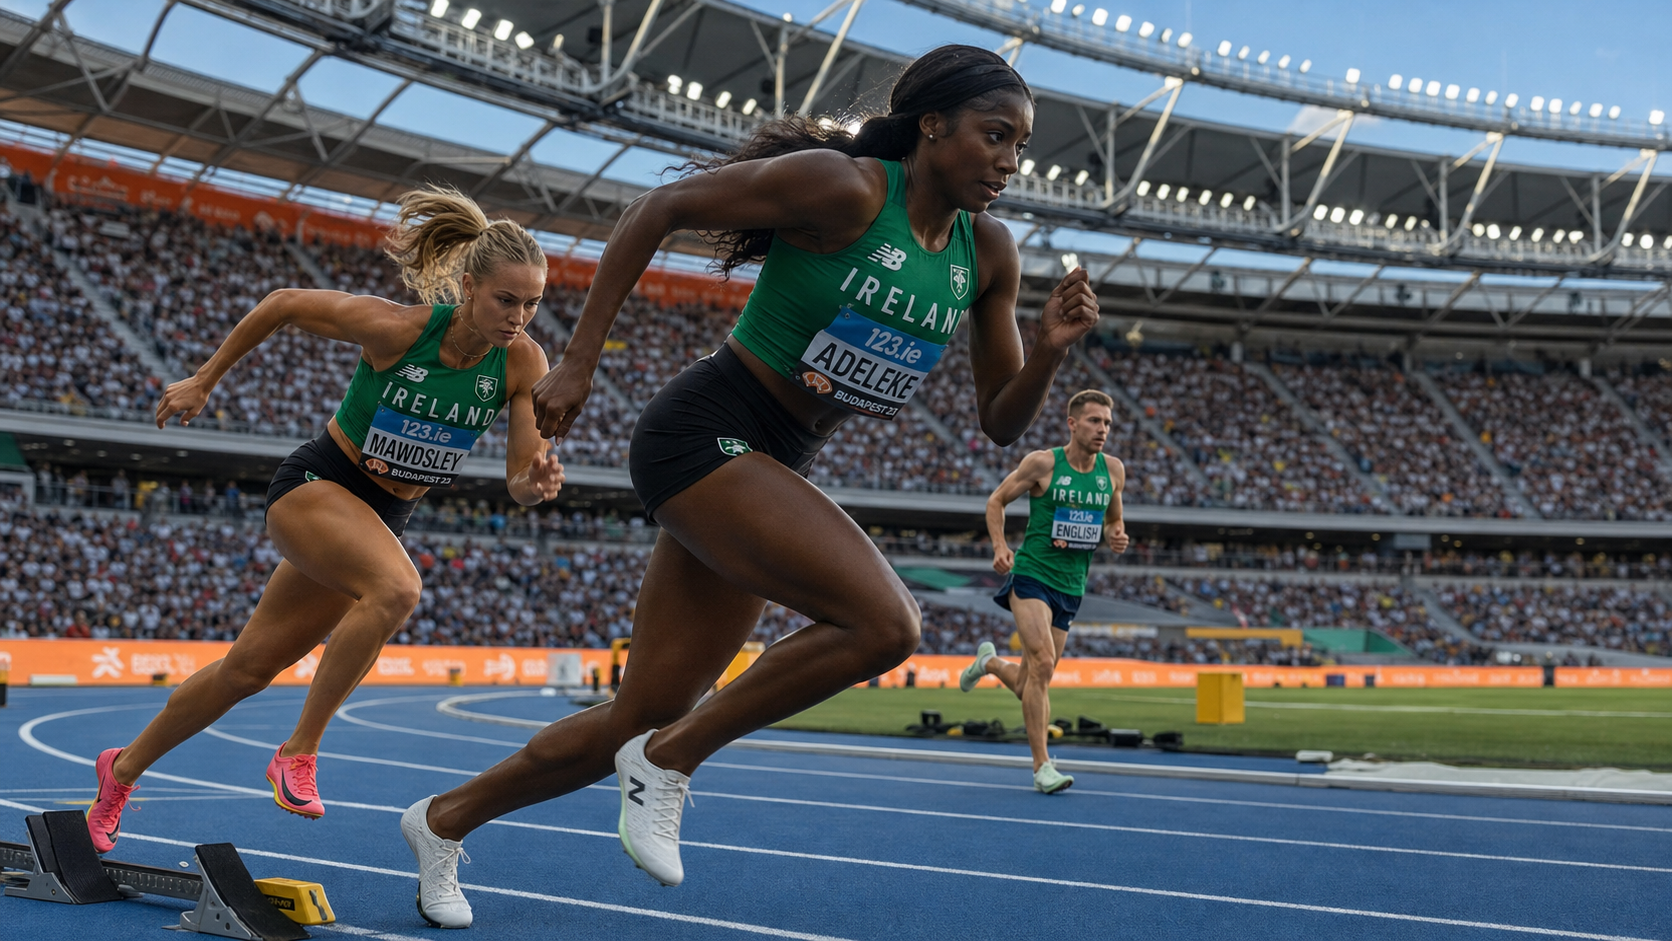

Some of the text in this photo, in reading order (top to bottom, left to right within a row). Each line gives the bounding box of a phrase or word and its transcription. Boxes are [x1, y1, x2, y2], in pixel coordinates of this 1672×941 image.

[864, 327, 923, 364] 123.ie
[811, 342, 919, 400] ADELEKE
[381, 381, 495, 427] IRELAND
[833, 389, 888, 414] BUDAPEST
[400, 418, 452, 444] 123.ie
[368, 432, 464, 472] MAWDSLEY
[391, 468, 441, 484] BUDAPEST
[1052, 488, 1110, 506] IRELAND
[1056, 523, 1099, 540] ENGLISH
